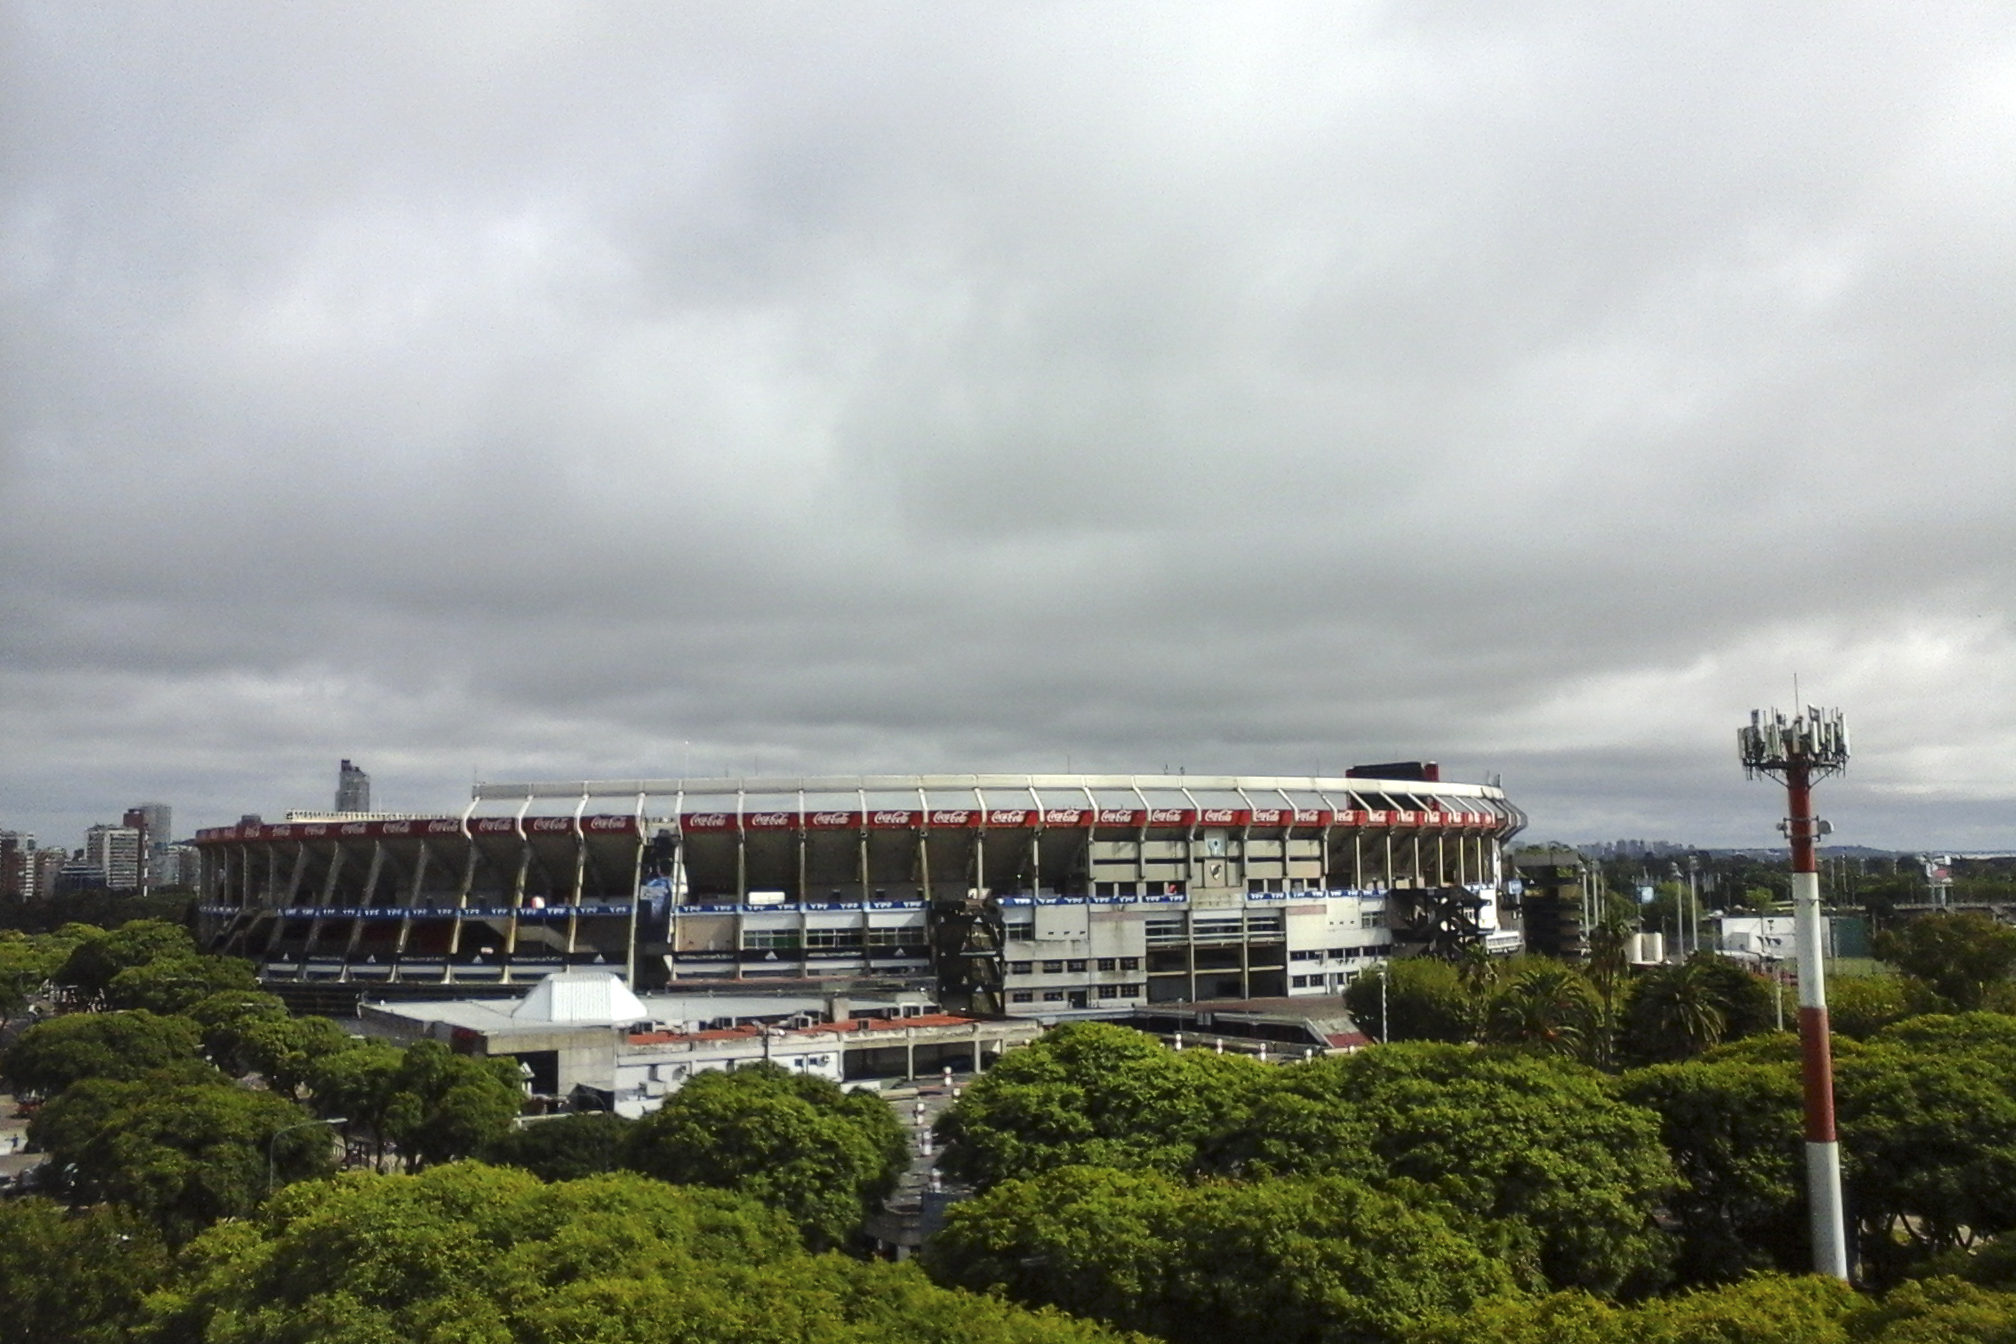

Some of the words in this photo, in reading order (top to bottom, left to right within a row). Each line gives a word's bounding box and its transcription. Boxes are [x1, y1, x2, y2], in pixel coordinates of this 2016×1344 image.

[690, 813, 727, 826] Coca-Cola
[752, 812, 789, 826] Coca-Cola
[813, 812, 850, 825] Coca-Cola
[874, 811, 911, 824] Coca-Cola
[932, 810, 969, 824] Coca-Cola
[991, 810, 1027, 824] Coca-Cola
[1046, 809, 1081, 824] Coca-Cola
[1101, 809, 1133, 824] Coca-Cola
